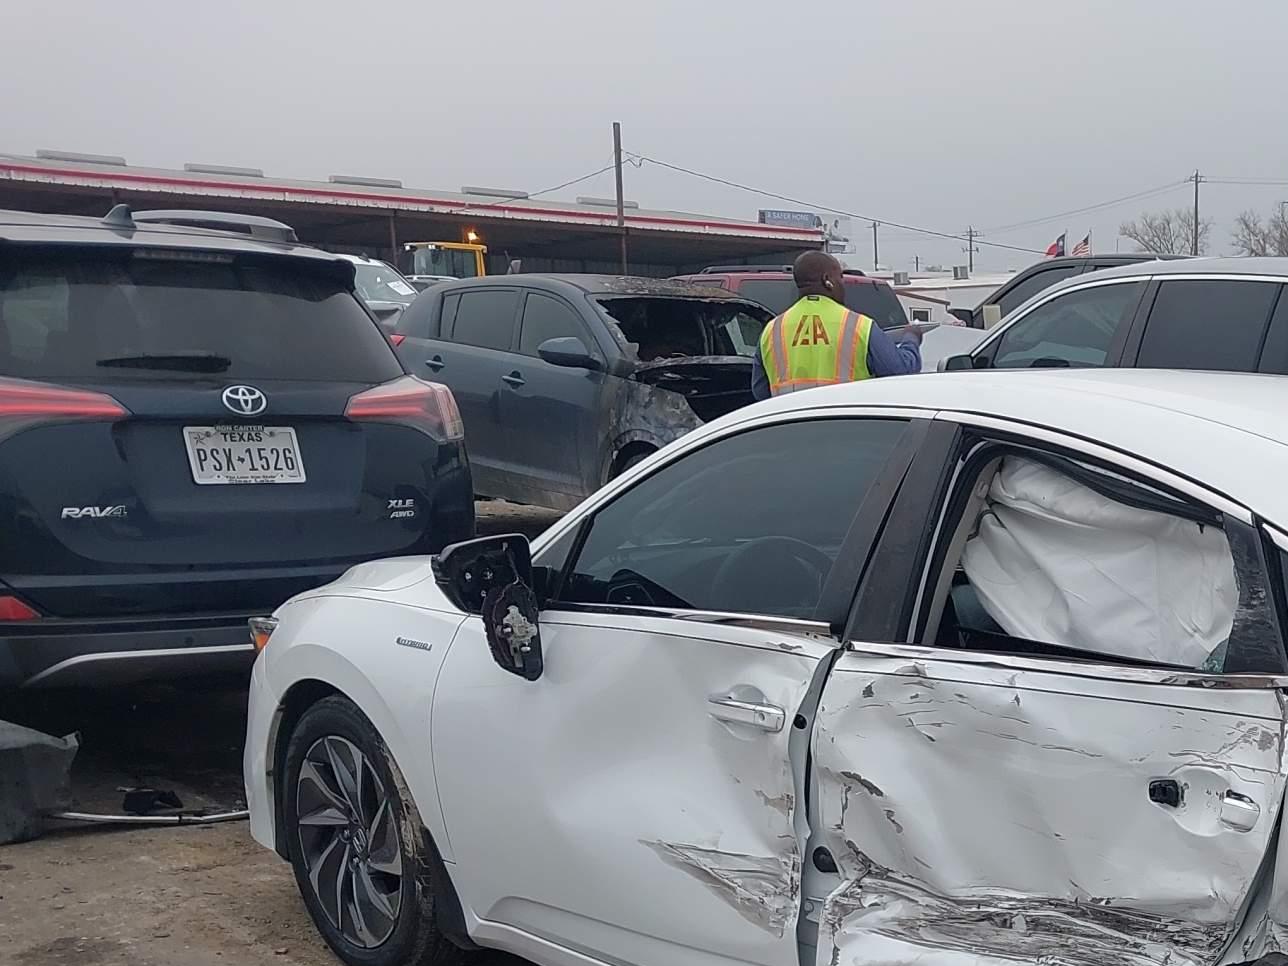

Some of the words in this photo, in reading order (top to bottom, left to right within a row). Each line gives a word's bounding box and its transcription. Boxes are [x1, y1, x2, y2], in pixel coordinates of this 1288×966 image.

[220, 432, 263, 442] TEXAS
[387, 498, 415, 509] XLE
[61, 504, 128, 519] RAV4
[390, 510, 415, 518] AWD
